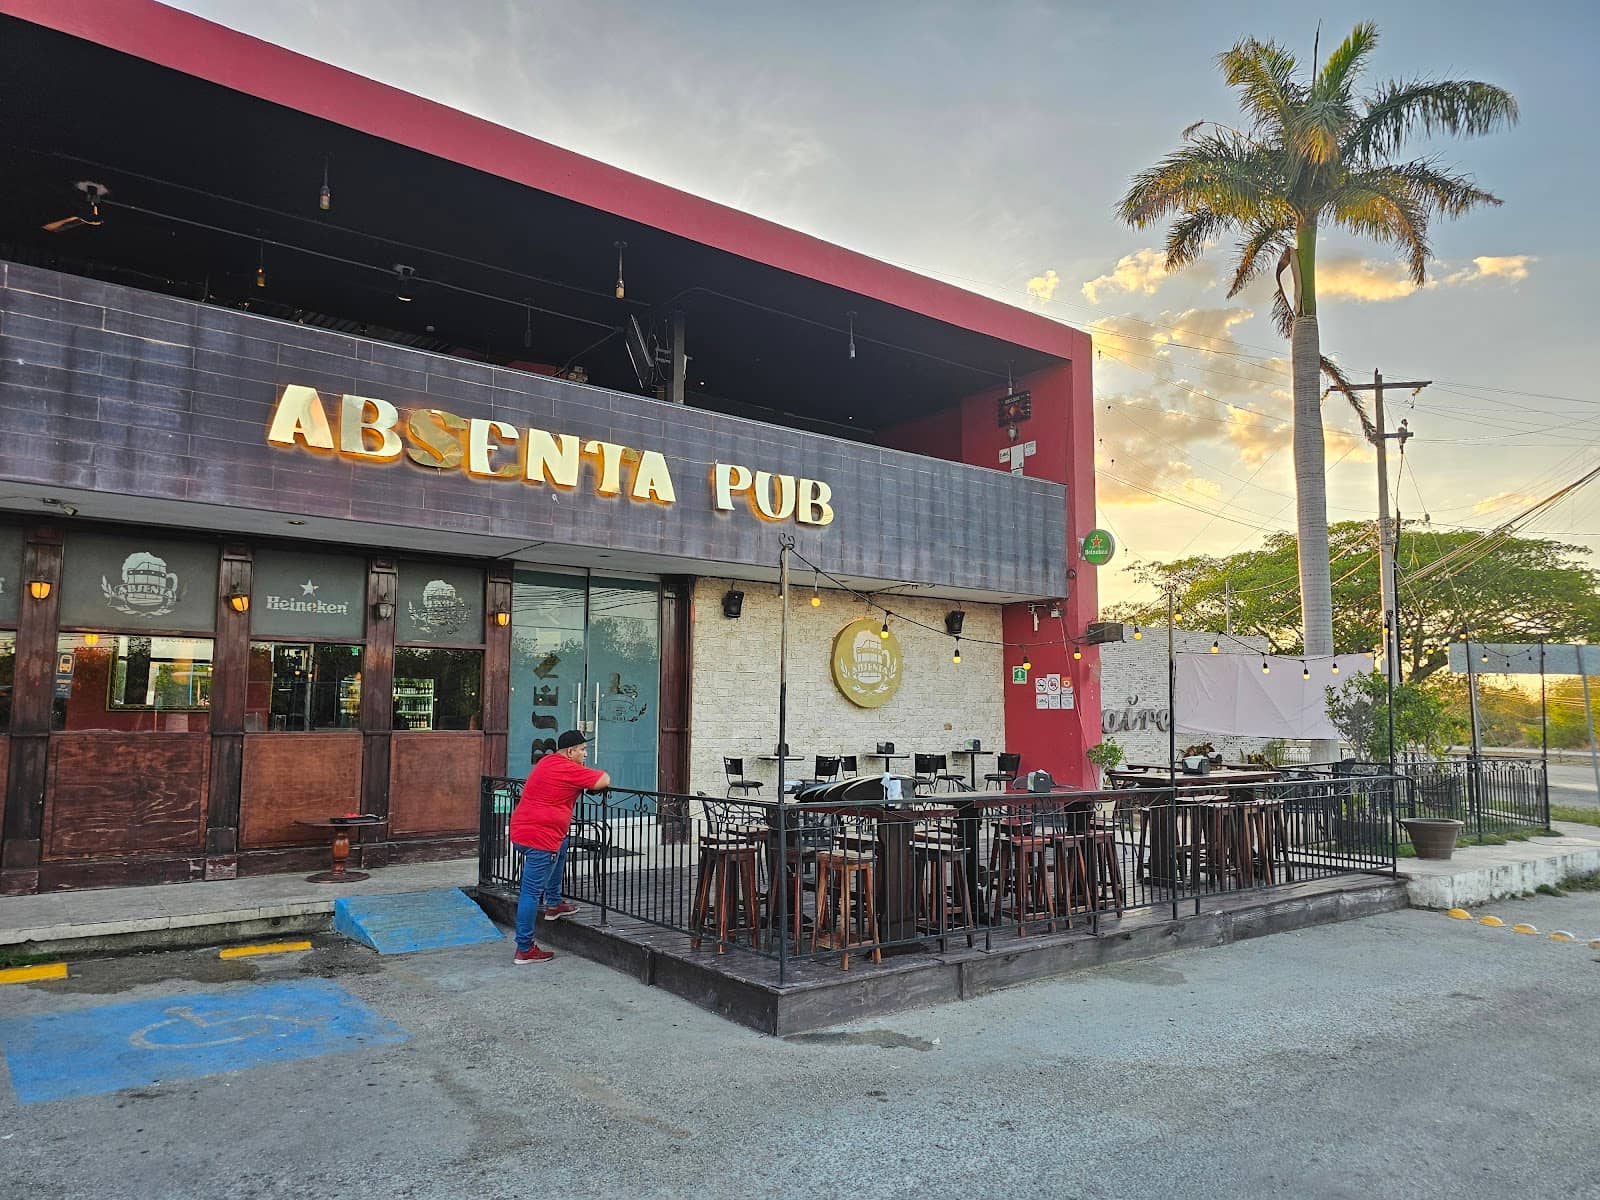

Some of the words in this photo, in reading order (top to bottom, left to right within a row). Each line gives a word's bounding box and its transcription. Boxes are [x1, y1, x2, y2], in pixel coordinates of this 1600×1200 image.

[268, 384, 676, 505] ABSENTA
[714, 463, 834, 526] PUB
[266, 595, 349, 616] Heineken
